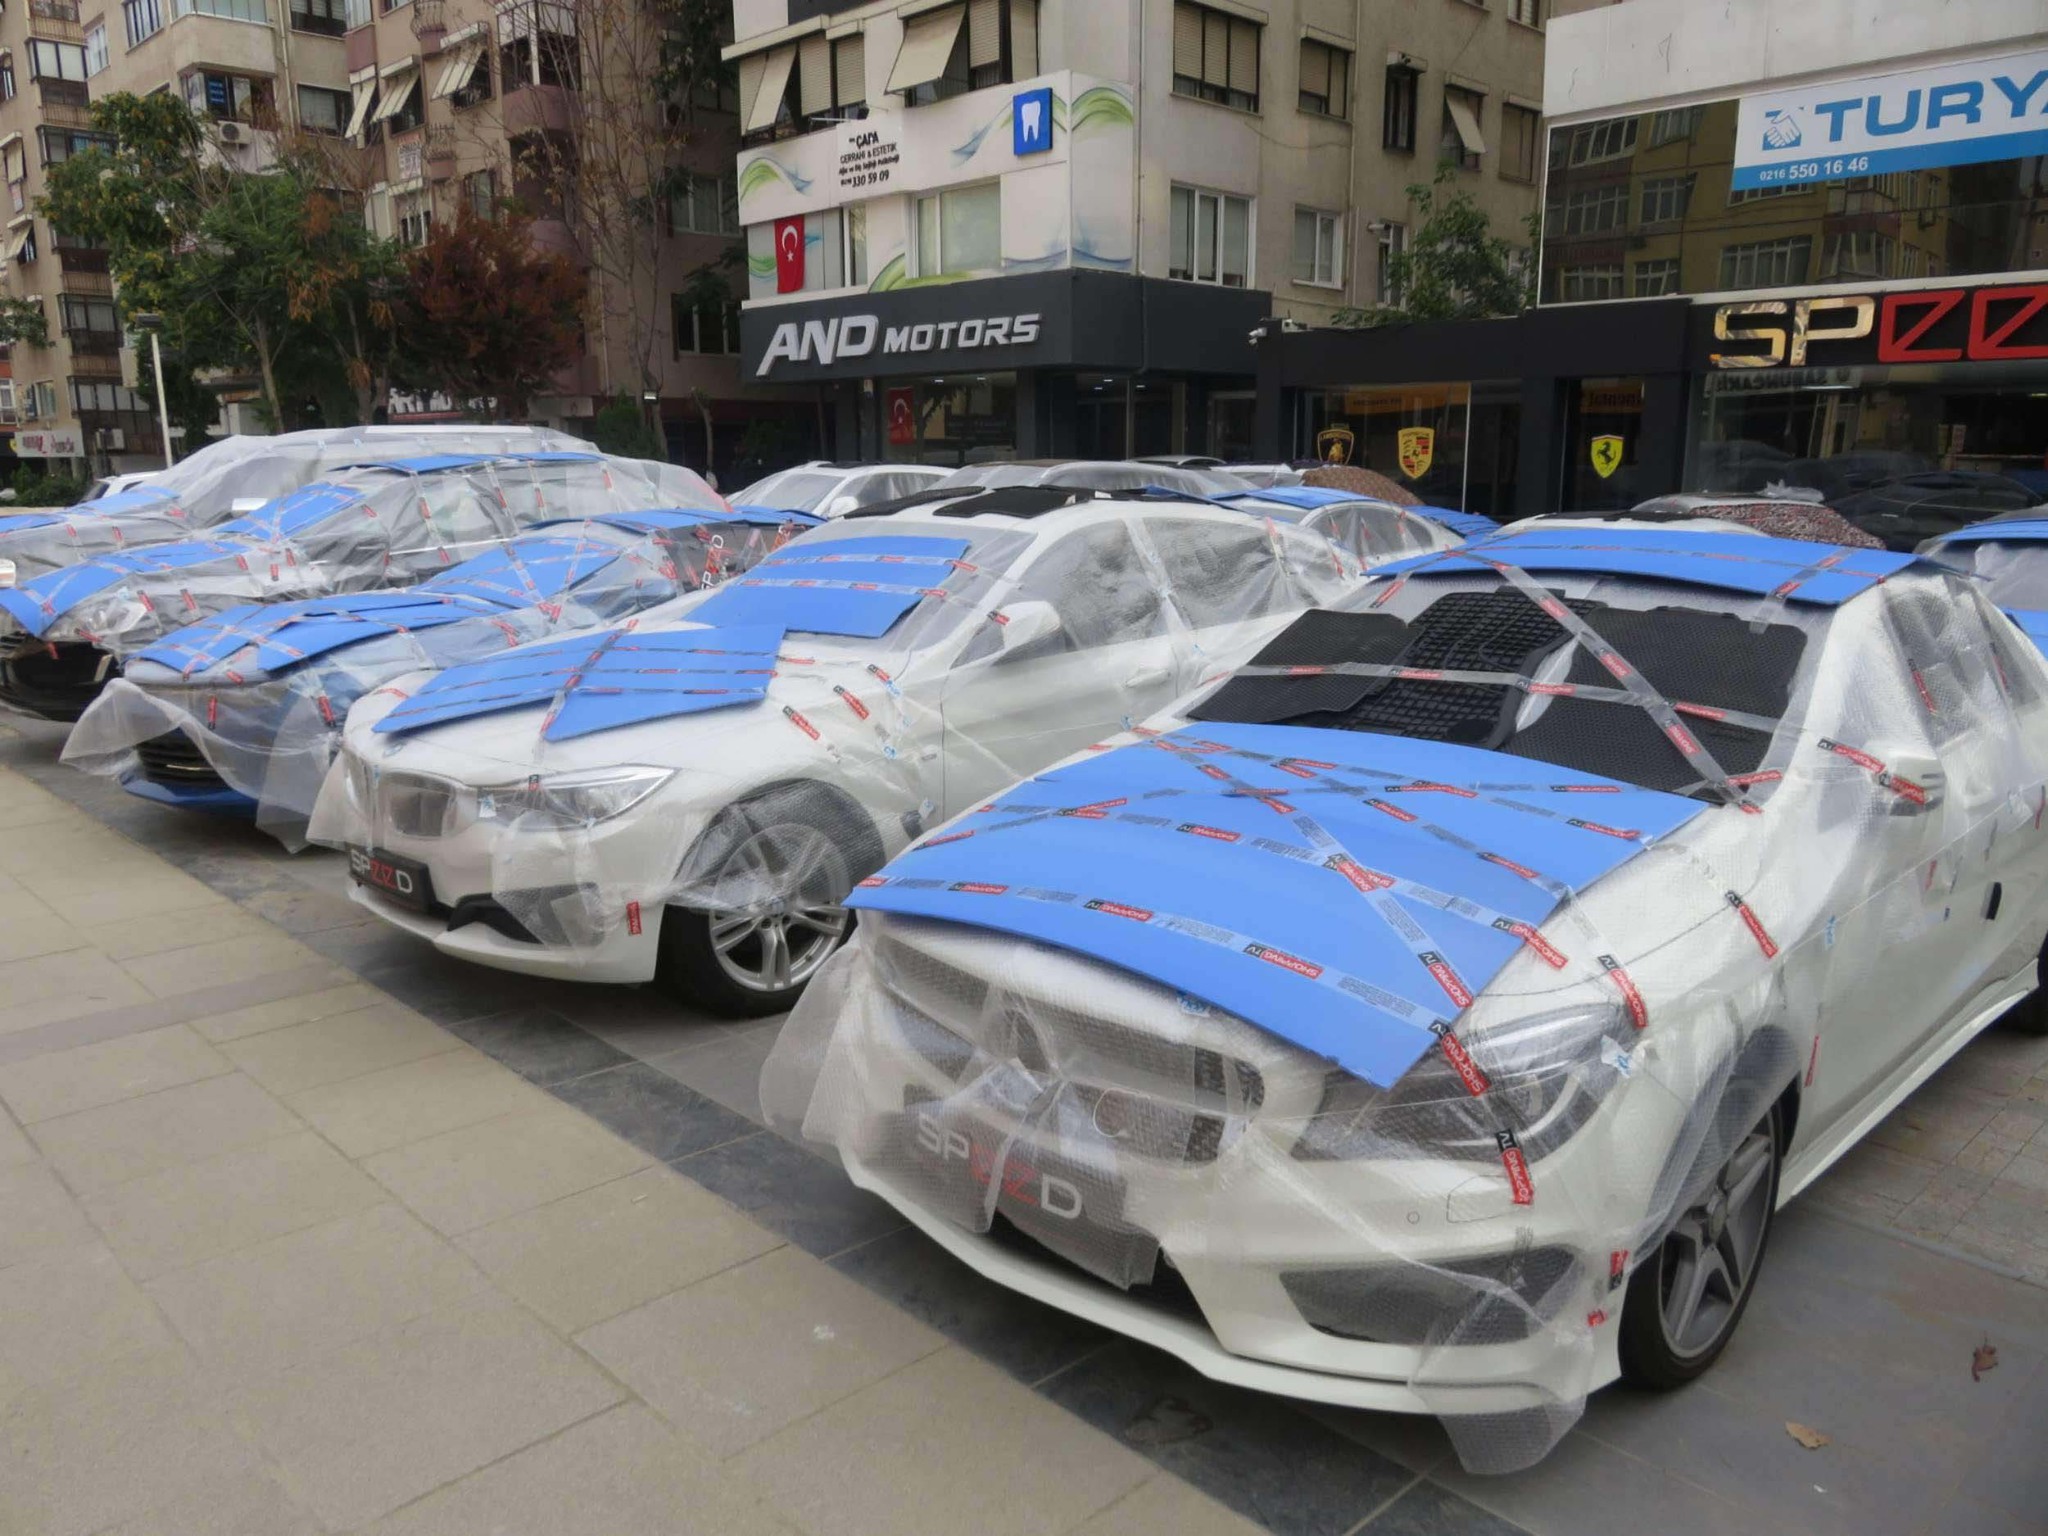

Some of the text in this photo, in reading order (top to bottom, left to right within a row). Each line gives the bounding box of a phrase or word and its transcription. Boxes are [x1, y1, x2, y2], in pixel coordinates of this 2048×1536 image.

[1814, 69, 2048, 142] TURY
[853, 174, 866, 188] 330
[868, 171, 878, 184] 59
[879, 169, 889, 181] 09
[1760, 156, 1869, 181] 0216 550 16 46
[756, 313, 1042, 377] AND MOTORS
[1245, 945, 1320, 978] SHOPPING TV
[1494, 920, 1565, 968] SHOPPING TV
[1422, 952, 1472, 1008] SHOPPING TV
[1612, 969, 1648, 1027] SHOPPING
[1442, 1034, 1488, 1094] SHOPPING
